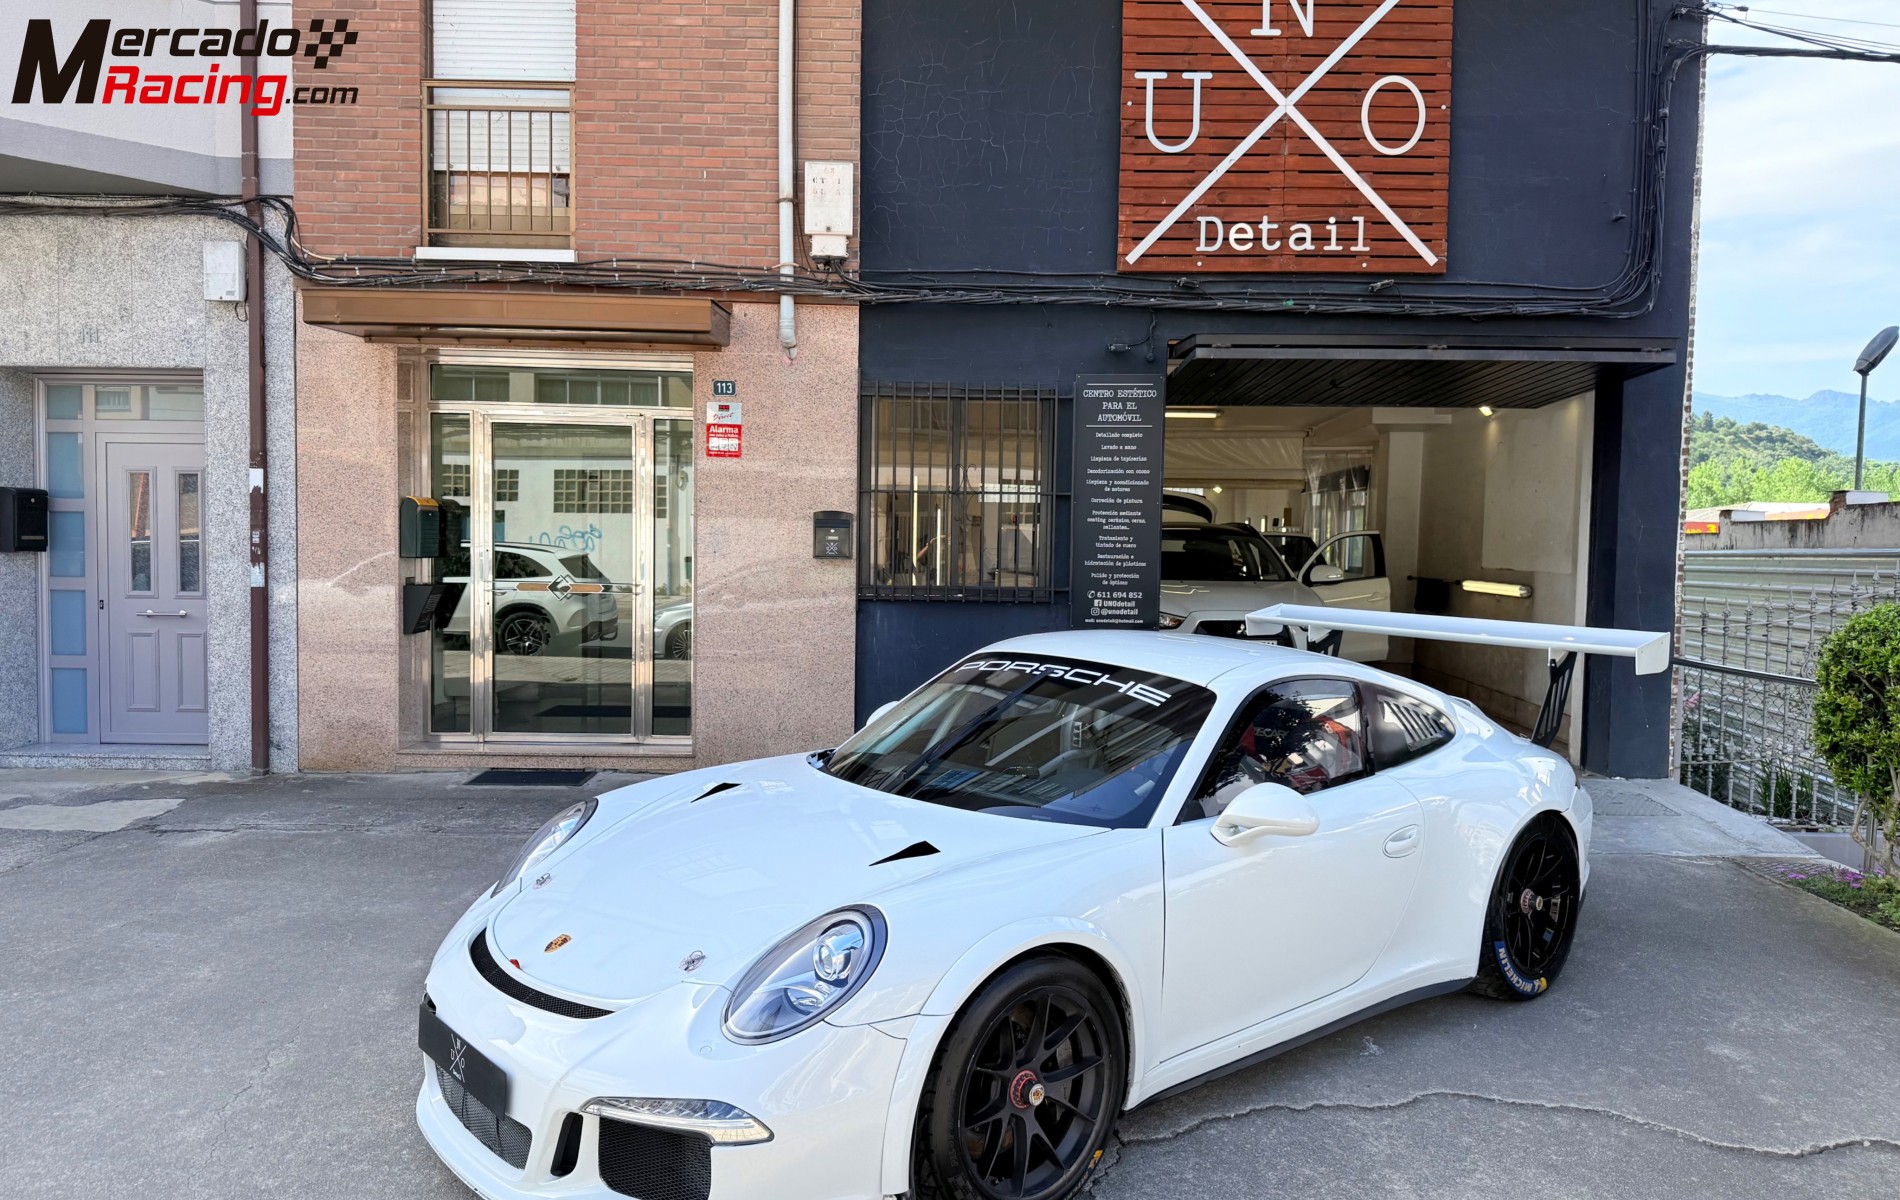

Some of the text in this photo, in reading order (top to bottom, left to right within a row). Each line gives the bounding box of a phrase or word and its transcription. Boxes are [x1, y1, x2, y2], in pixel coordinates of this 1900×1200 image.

[1195, 215, 1370, 252] Detail
[716, 383, 732, 394] 113
[1083, 387, 1157, 398] CENTRO ESTÉTICO
[1102, 401, 1137, 410] PARA EL
[1097, 411, 1142, 422] AUTOMÓVIL
[709, 425, 738, 433] Alarma
[1112, 591, 1127, 599] 694
[1103, 600, 1136, 608] UNOdetail
[1101, 608, 1139, 616] @unodetail
[955, 661, 1172, 707] PORSCHE
[1498, 947, 1533, 993] MICHELIN
